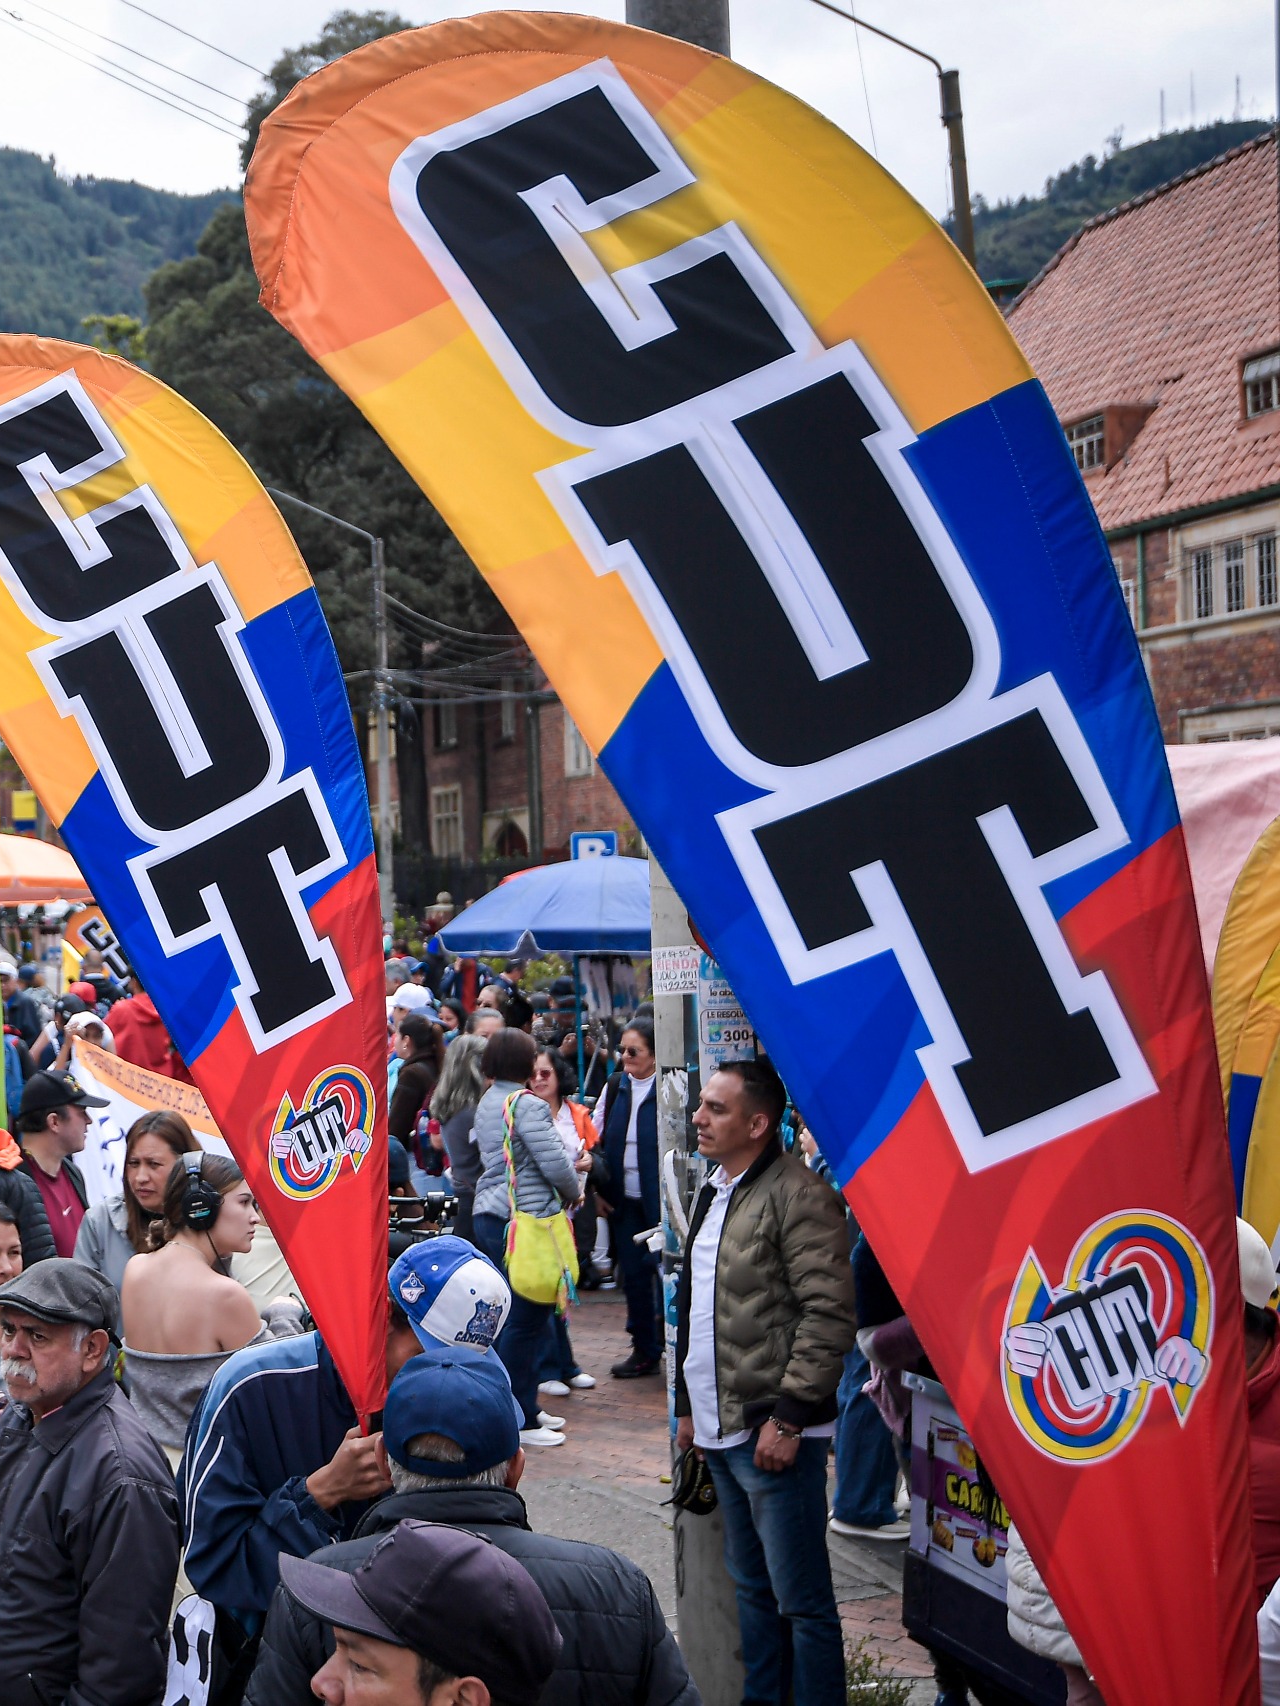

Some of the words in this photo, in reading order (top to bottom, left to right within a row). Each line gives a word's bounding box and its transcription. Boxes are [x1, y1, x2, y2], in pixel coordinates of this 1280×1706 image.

[392, 62, 1156, 1170] CUT
[78, 917, 133, 998] CU
[707, 1011, 715, 1019] LE
[290, 1103, 345, 1173] CUT
[1042, 1283, 1155, 1408] CUT
